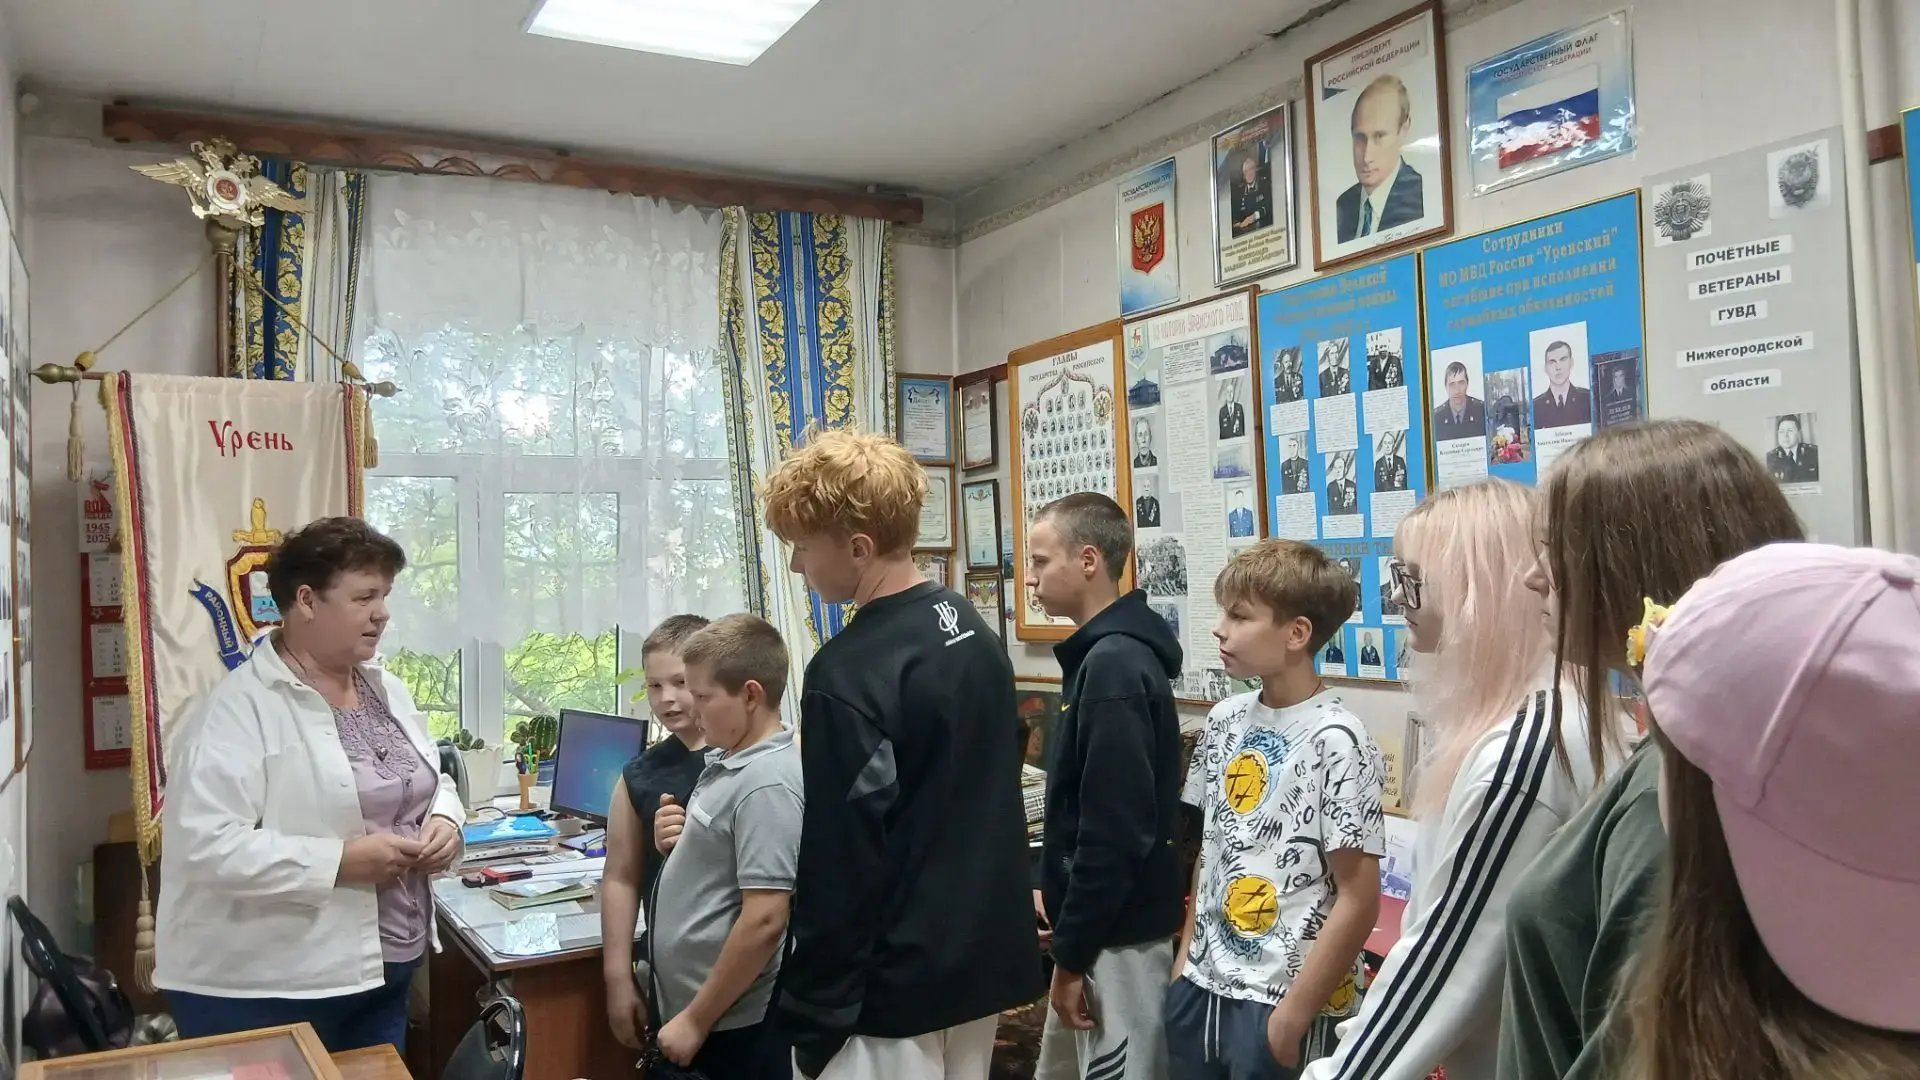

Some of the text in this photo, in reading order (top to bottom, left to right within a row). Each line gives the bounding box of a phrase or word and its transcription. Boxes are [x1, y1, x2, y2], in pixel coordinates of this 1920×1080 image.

[1327, 39, 1420, 87] РОССИЙСКОЙ ФЕДЕРАЦИИ
[1351, 39, 1392, 63] ПРЕЗИДЕНТ
[1493, 33, 1599, 78] ГОСУДАРСТВЕННЫЙ ФЛАГ
[1483, 221, 1564, 253] Сотрудники
[1695, 240, 1781, 266] ПОЧЁТНЫЕ
[1459, 263, 1488, 283] МВД
[1488, 254, 1534, 275] России
[1698, 269, 1781, 295] ВЕТЕРАНЫ
[1718, 303, 1757, 321] ГУВД
[1686, 336, 1803, 362] Нижегородской
[1711, 376, 1769, 391] области
[86, 523, 110, 533] 1945
[86, 535, 111, 543] 2025
[204, 591, 233, 649] РАЙОННЫЙ
